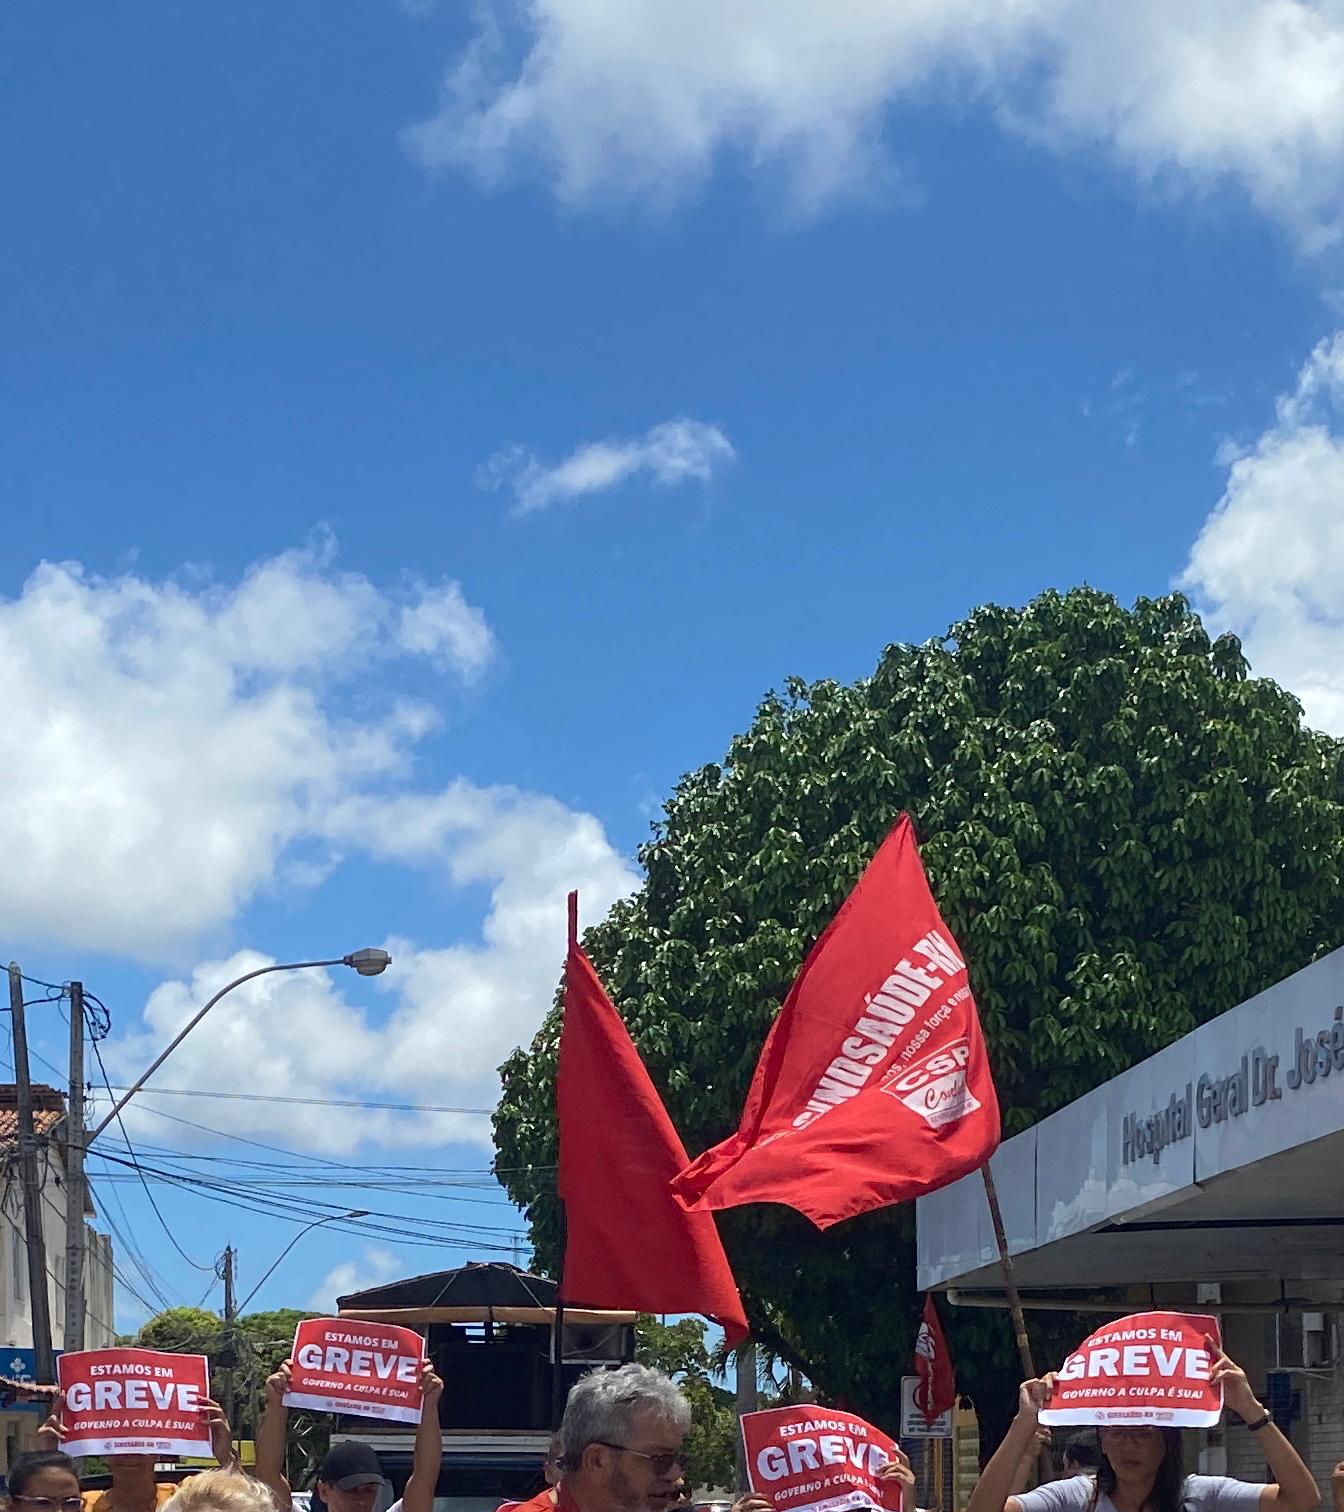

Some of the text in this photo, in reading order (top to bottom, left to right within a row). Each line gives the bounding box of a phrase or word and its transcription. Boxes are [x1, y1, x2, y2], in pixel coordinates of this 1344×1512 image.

[896, 1046, 970, 1092] CSP
[1121, 1083, 1193, 1166] Hospital
[1195, 1056, 1249, 1129] Geral
[1251, 1045, 1282, 1107] Dr.
[325, 1332, 399, 1350] ESTAMOS EM
[1087, 1328, 1183, 1348] ESTAMOS EM
[90, 1364, 173, 1378] ESTAMOS EM
[298, 1343, 419, 1384] GREVE
[1056, 1344, 1211, 1382] GREVE
[66, 1379, 200, 1412] GREVE
[346, 1382, 352, 1391] A
[1062, 1387, 1116, 1400] GOVERNO
[1118, 1386, 1126, 1396] A
[1129, 1387, 1165, 1397] CULPA
[74, 1419, 121, 1431] GOVERNO
[123, 1418, 130, 1428] A
[132, 1418, 163, 1429] CULPA
[779, 1420, 846, 1437] ESTAMOS
[774, 1480, 822, 1501] GOVERNO
